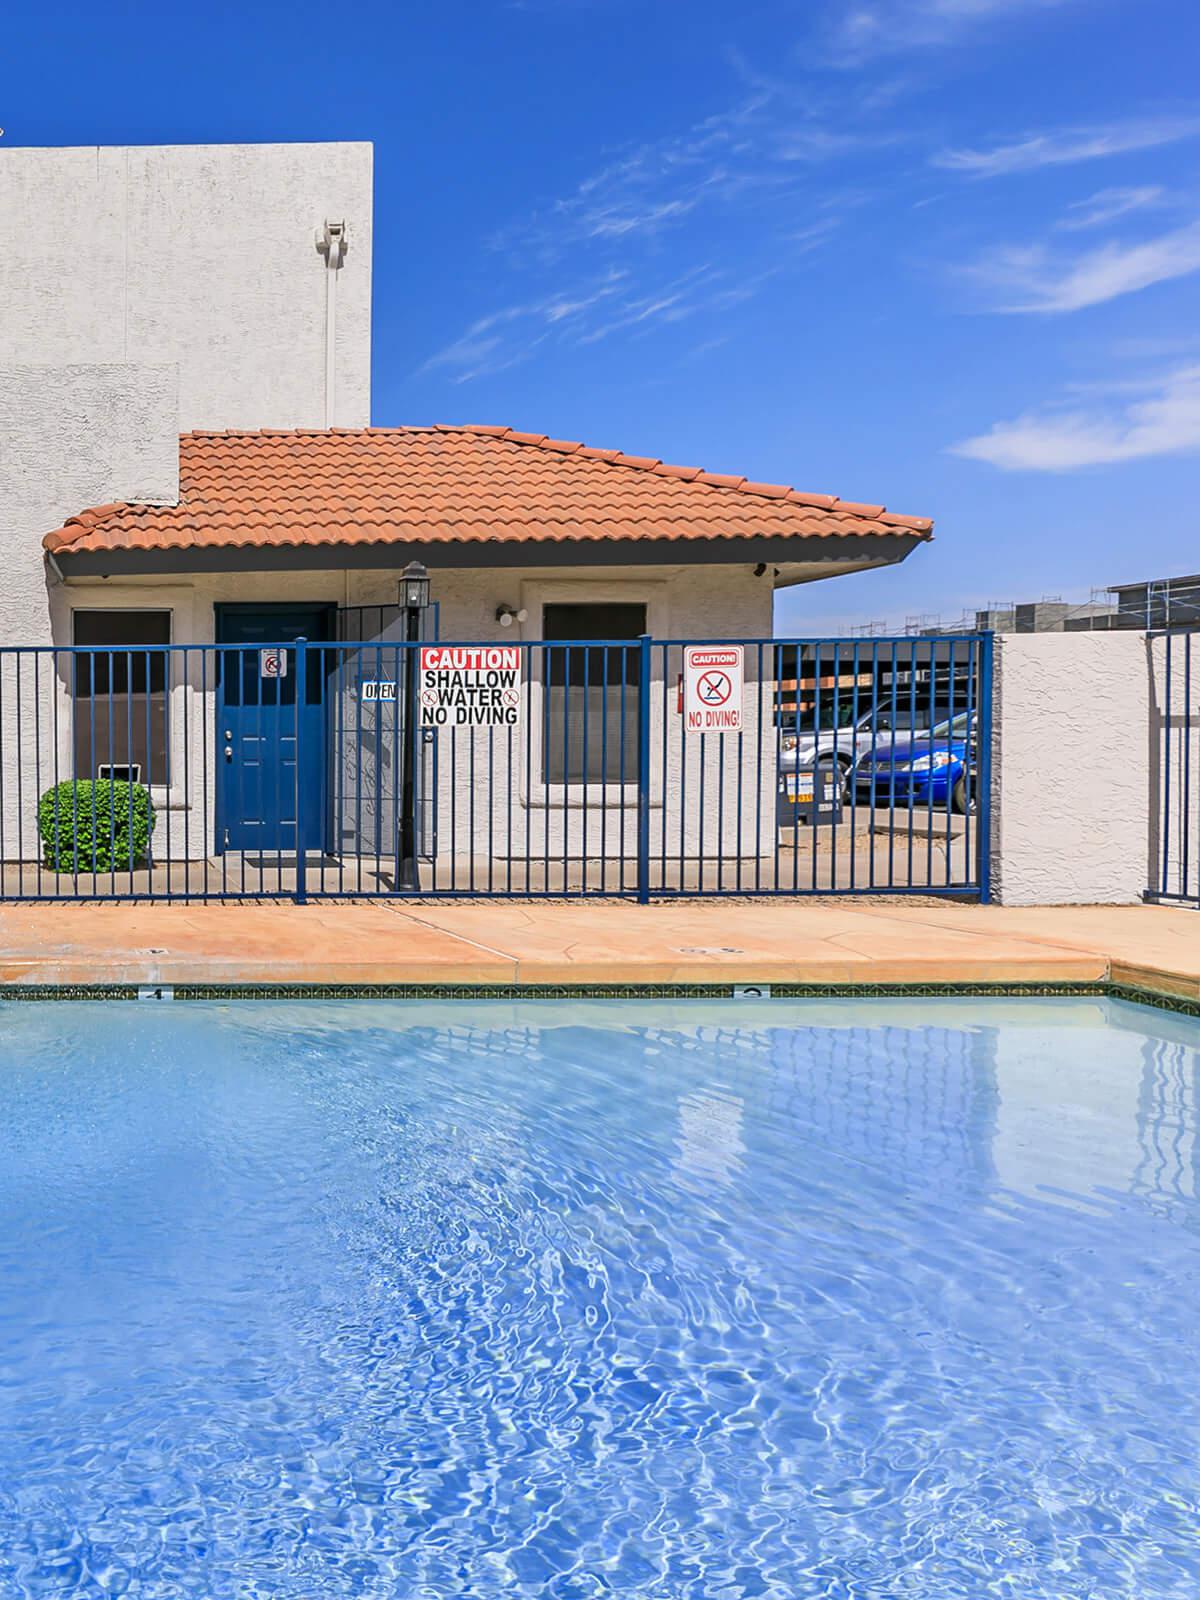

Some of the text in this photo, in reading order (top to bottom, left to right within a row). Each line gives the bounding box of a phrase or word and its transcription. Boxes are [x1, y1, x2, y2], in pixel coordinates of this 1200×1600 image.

[425, 649, 517, 669] CAUTION
[693, 654, 736, 664] CAUTION!
[425, 671, 516, 688] SHALLOW
[438, 689, 502, 706] WATER
[423, 707, 517, 724] NO DIVING
[689, 710, 740, 727] NO DIVING!
